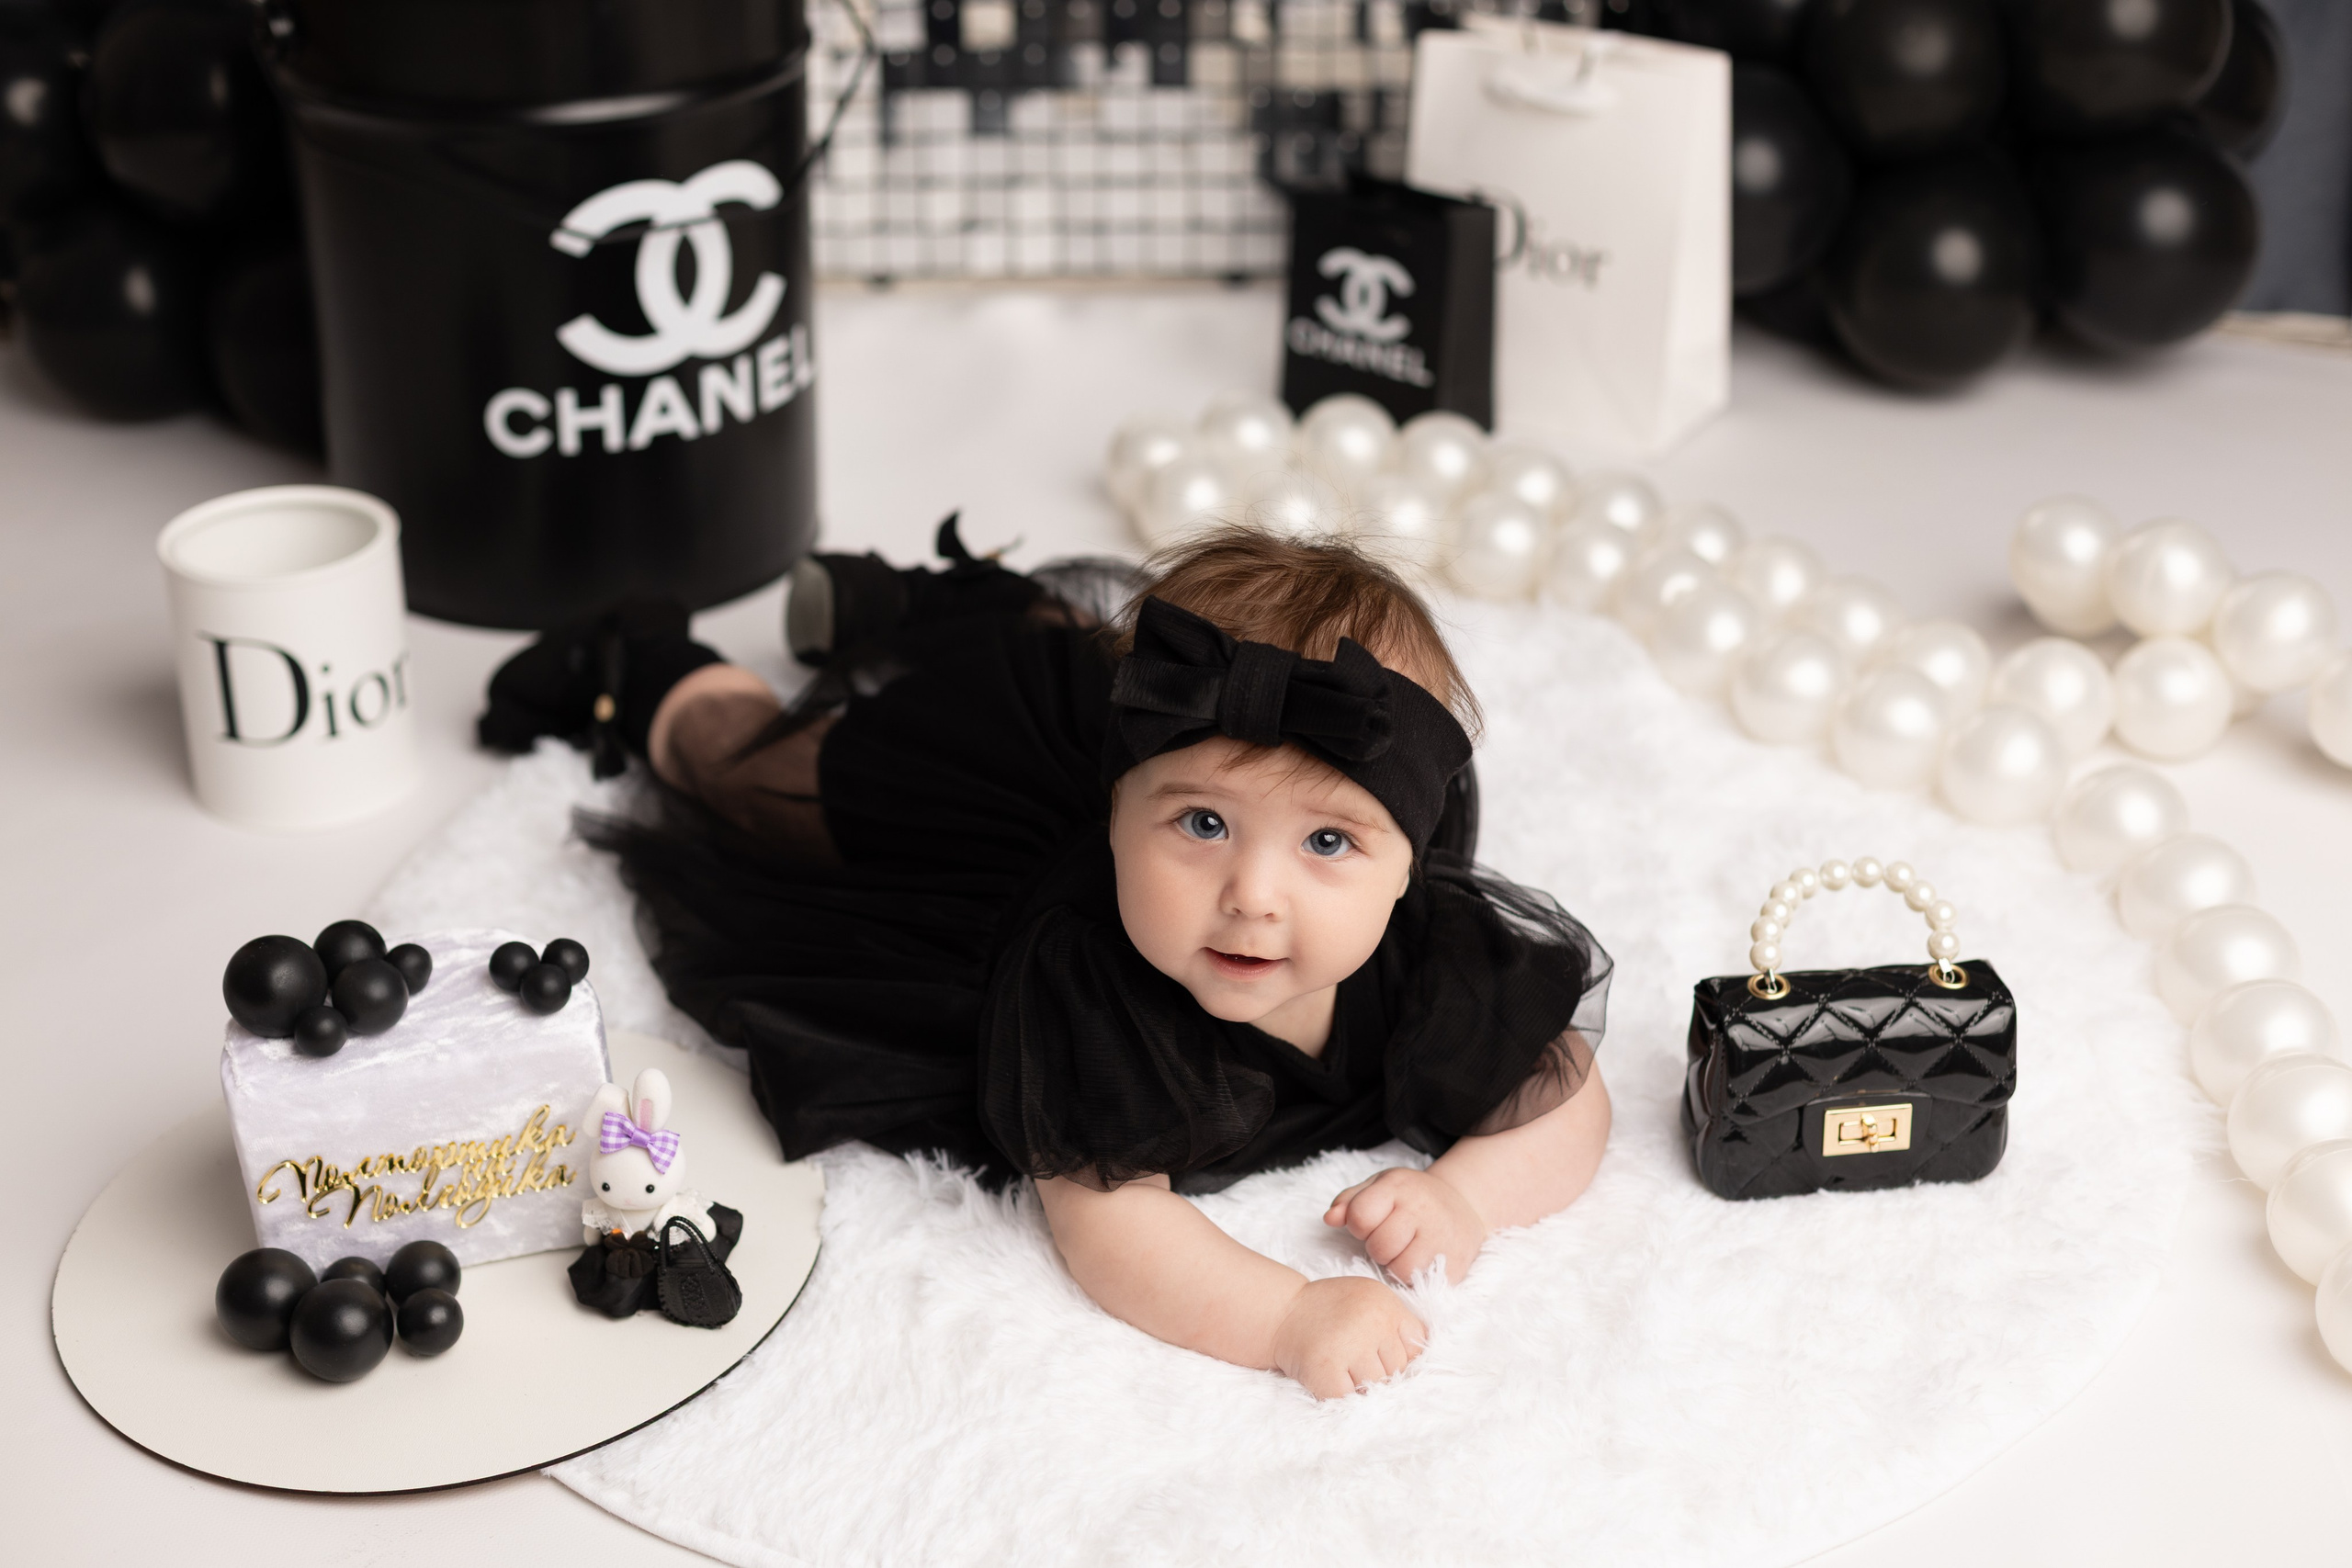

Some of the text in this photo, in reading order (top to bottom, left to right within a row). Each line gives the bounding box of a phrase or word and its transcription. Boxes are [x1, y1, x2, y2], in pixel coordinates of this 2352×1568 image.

[483, 321, 817, 458] CHANEL
[1286, 317, 1435, 389] CHANEL
[195, 628, 410, 749] Dior
